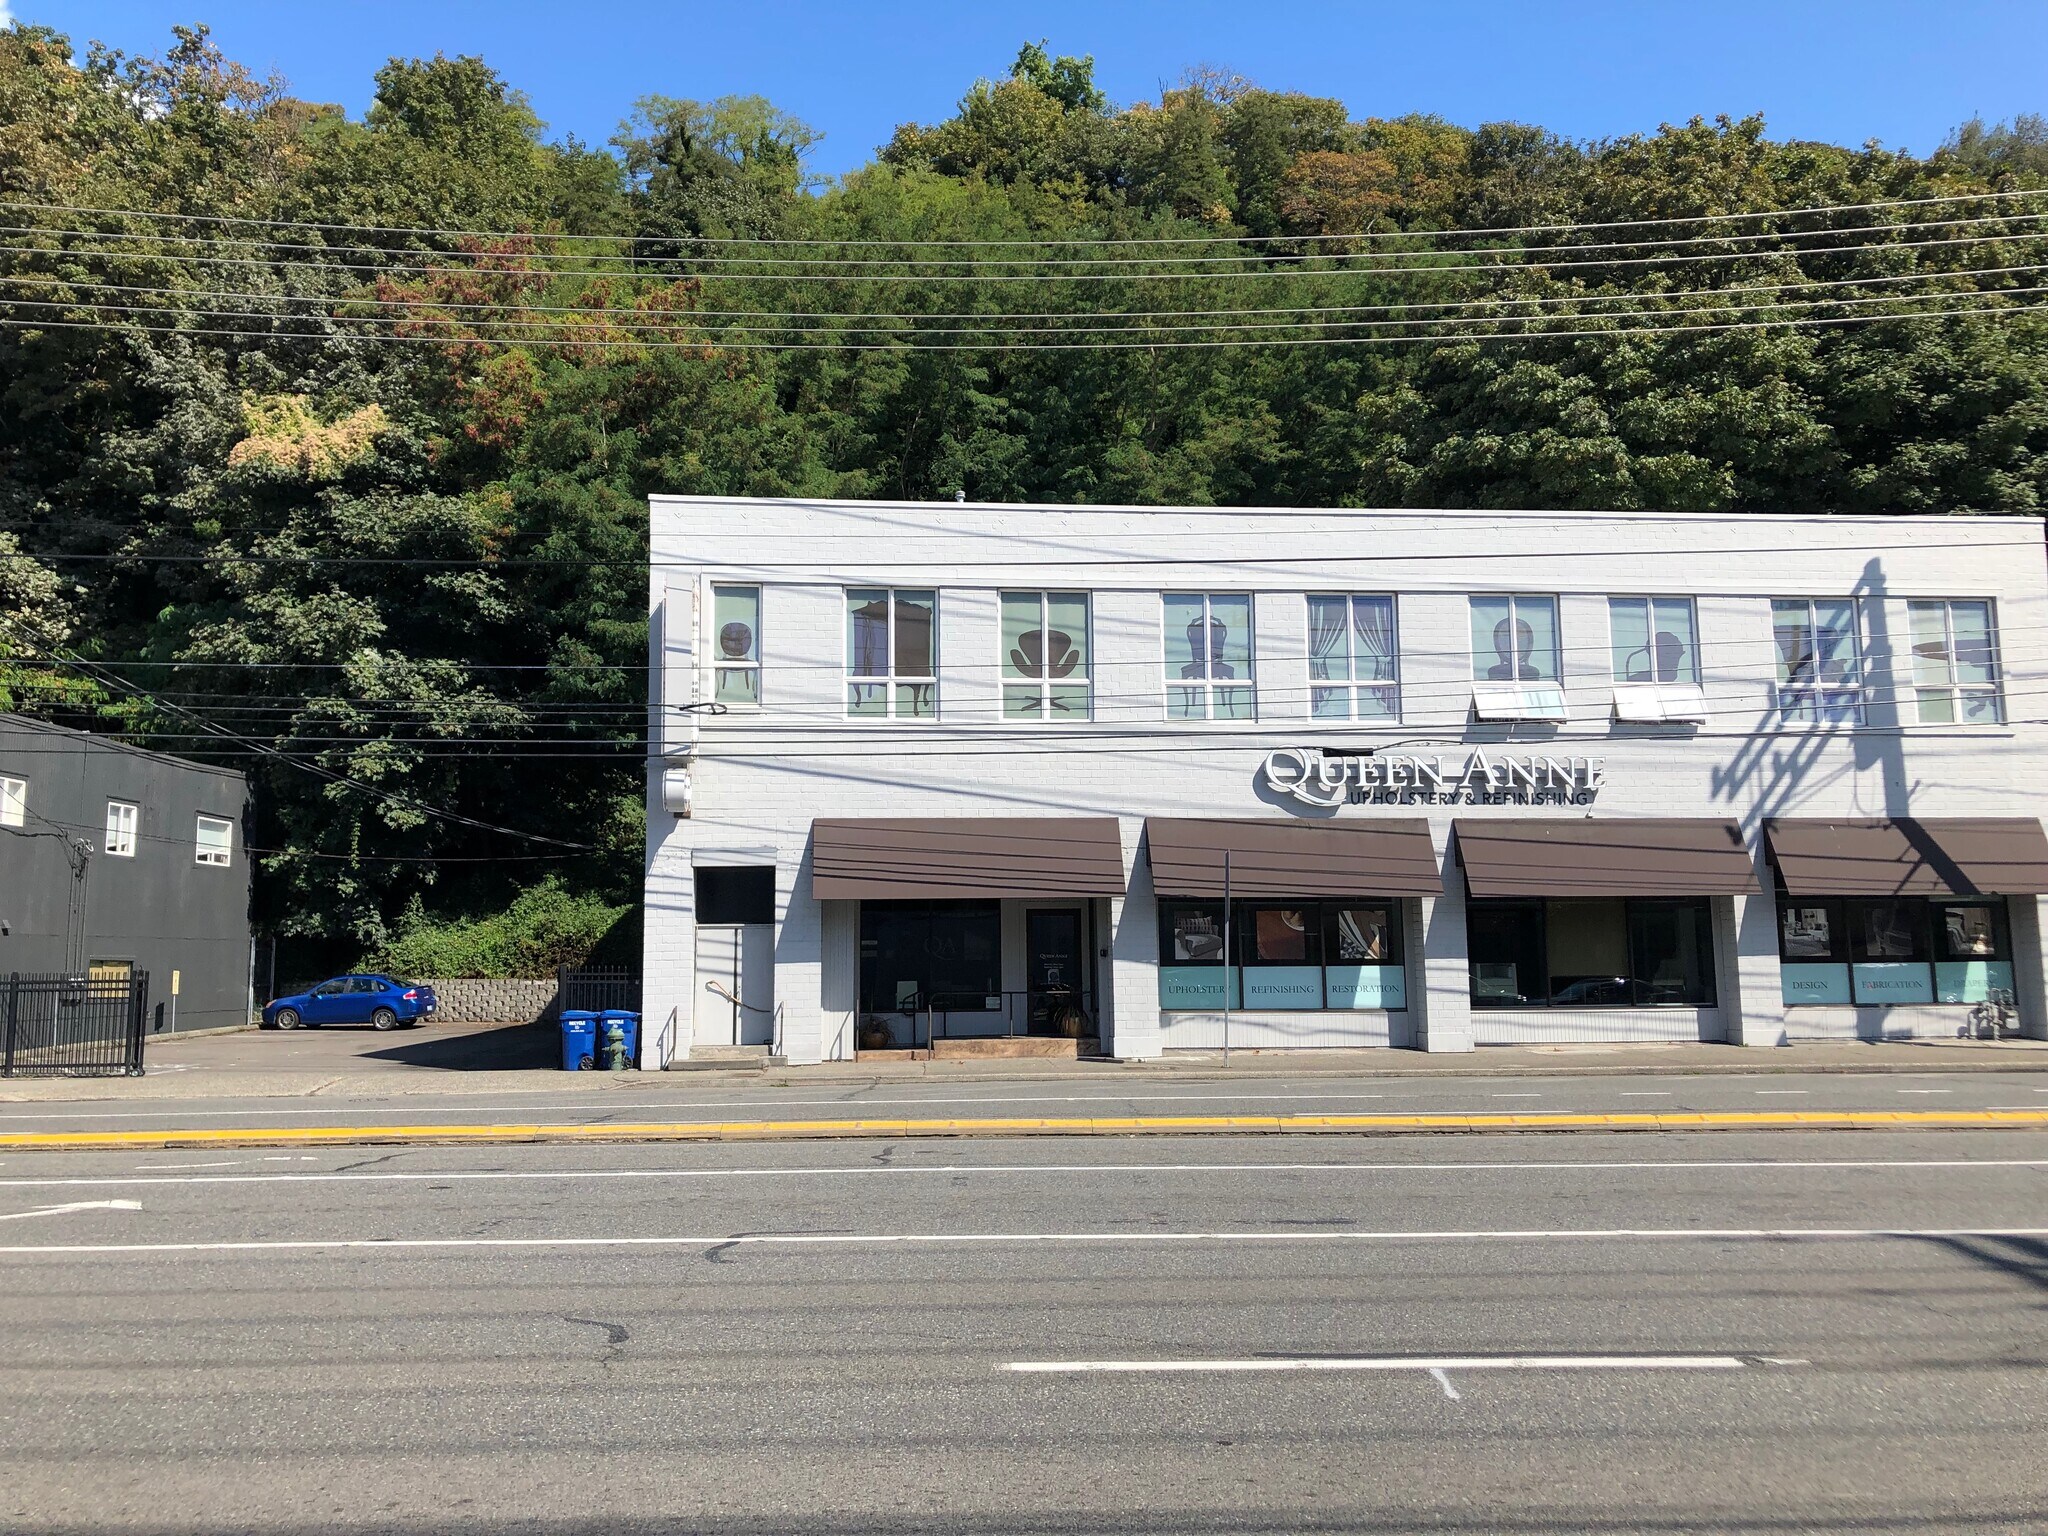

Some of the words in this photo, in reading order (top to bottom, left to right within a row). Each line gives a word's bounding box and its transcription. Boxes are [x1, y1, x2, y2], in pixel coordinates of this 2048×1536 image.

[1264, 744, 1446, 807] QUEEN
[1458, 744, 1607, 789] ANNE
[1350, 791, 1458, 806] UPHOLSTERY
[1465, 791, 1477, 806] &
[1483, 791, 1588, 806] REFINISHING
[1331, 984, 1399, 993] RESTORATION
[1792, 981, 1828, 990] DESIGN
[1862, 980, 1923, 989] FABRICATION
[1251, 985, 1315, 994] REFINISHING
